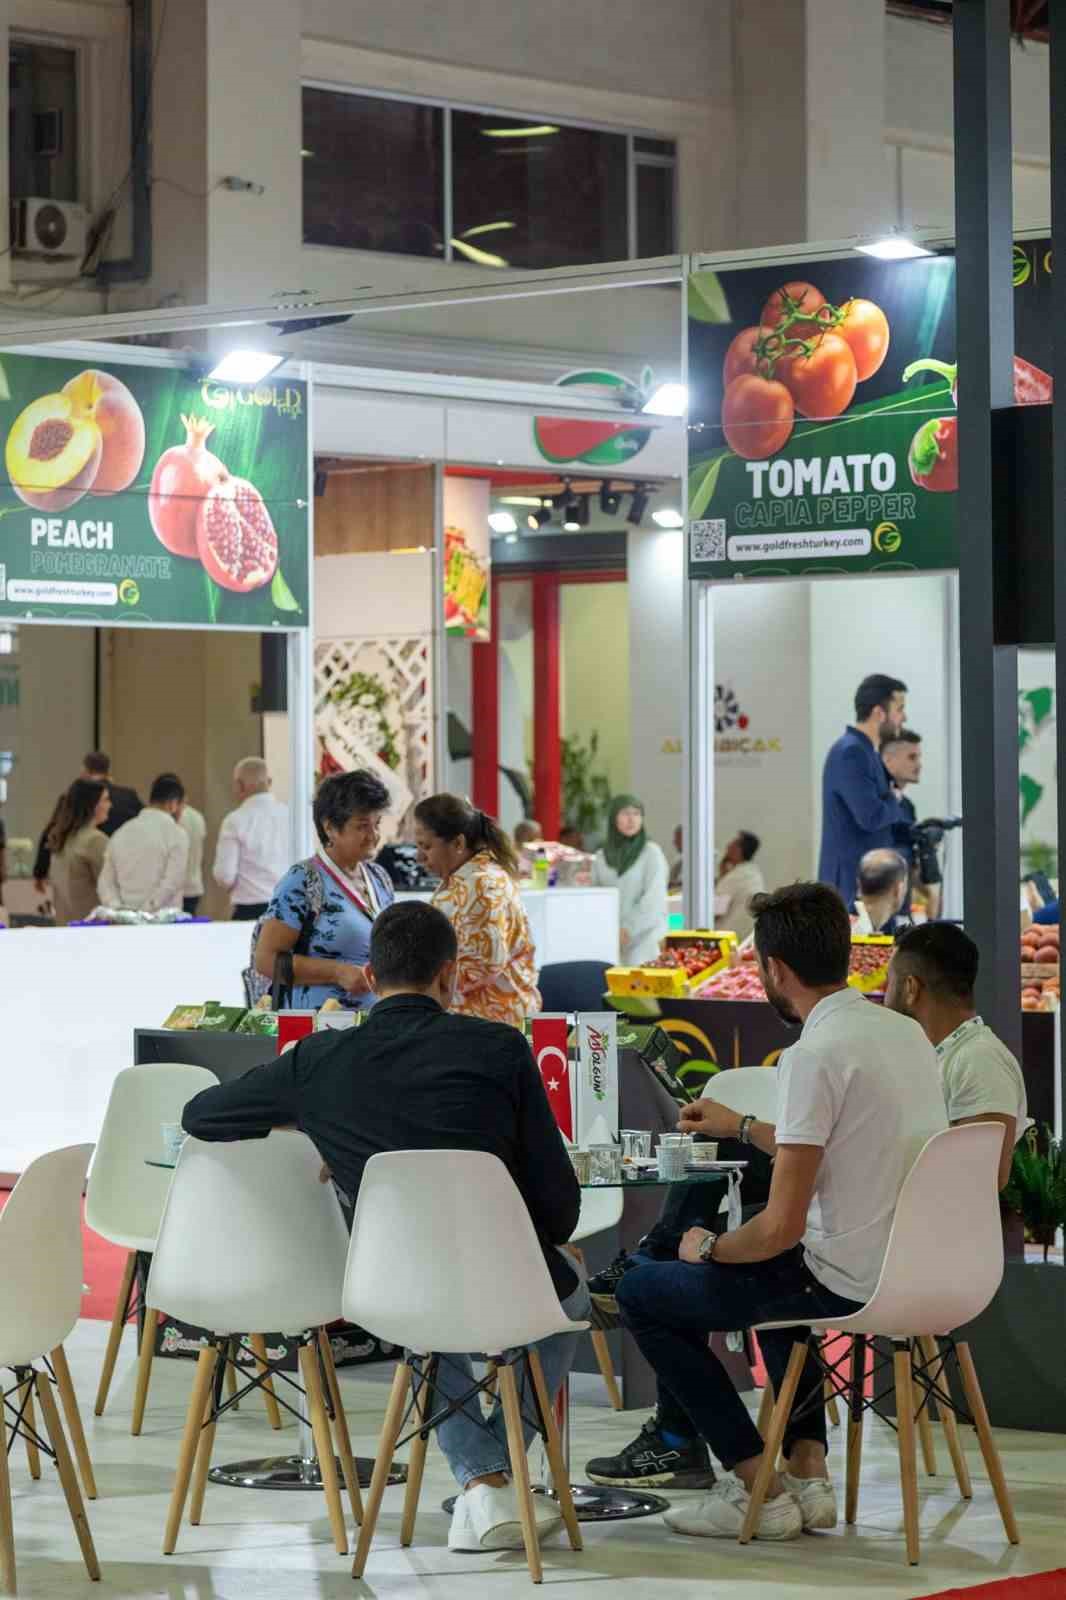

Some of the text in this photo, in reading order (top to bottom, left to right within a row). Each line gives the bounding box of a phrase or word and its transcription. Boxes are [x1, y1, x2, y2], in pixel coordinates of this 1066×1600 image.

[745, 453, 896, 498] TOMATO
[735, 493, 916, 528] CAPIA PEPPER
[31, 518, 114, 550] PEACH
[735, 538, 864, 552] www.goldfreshturkey.com
[31, 551, 172, 579] POMEGRANATE
